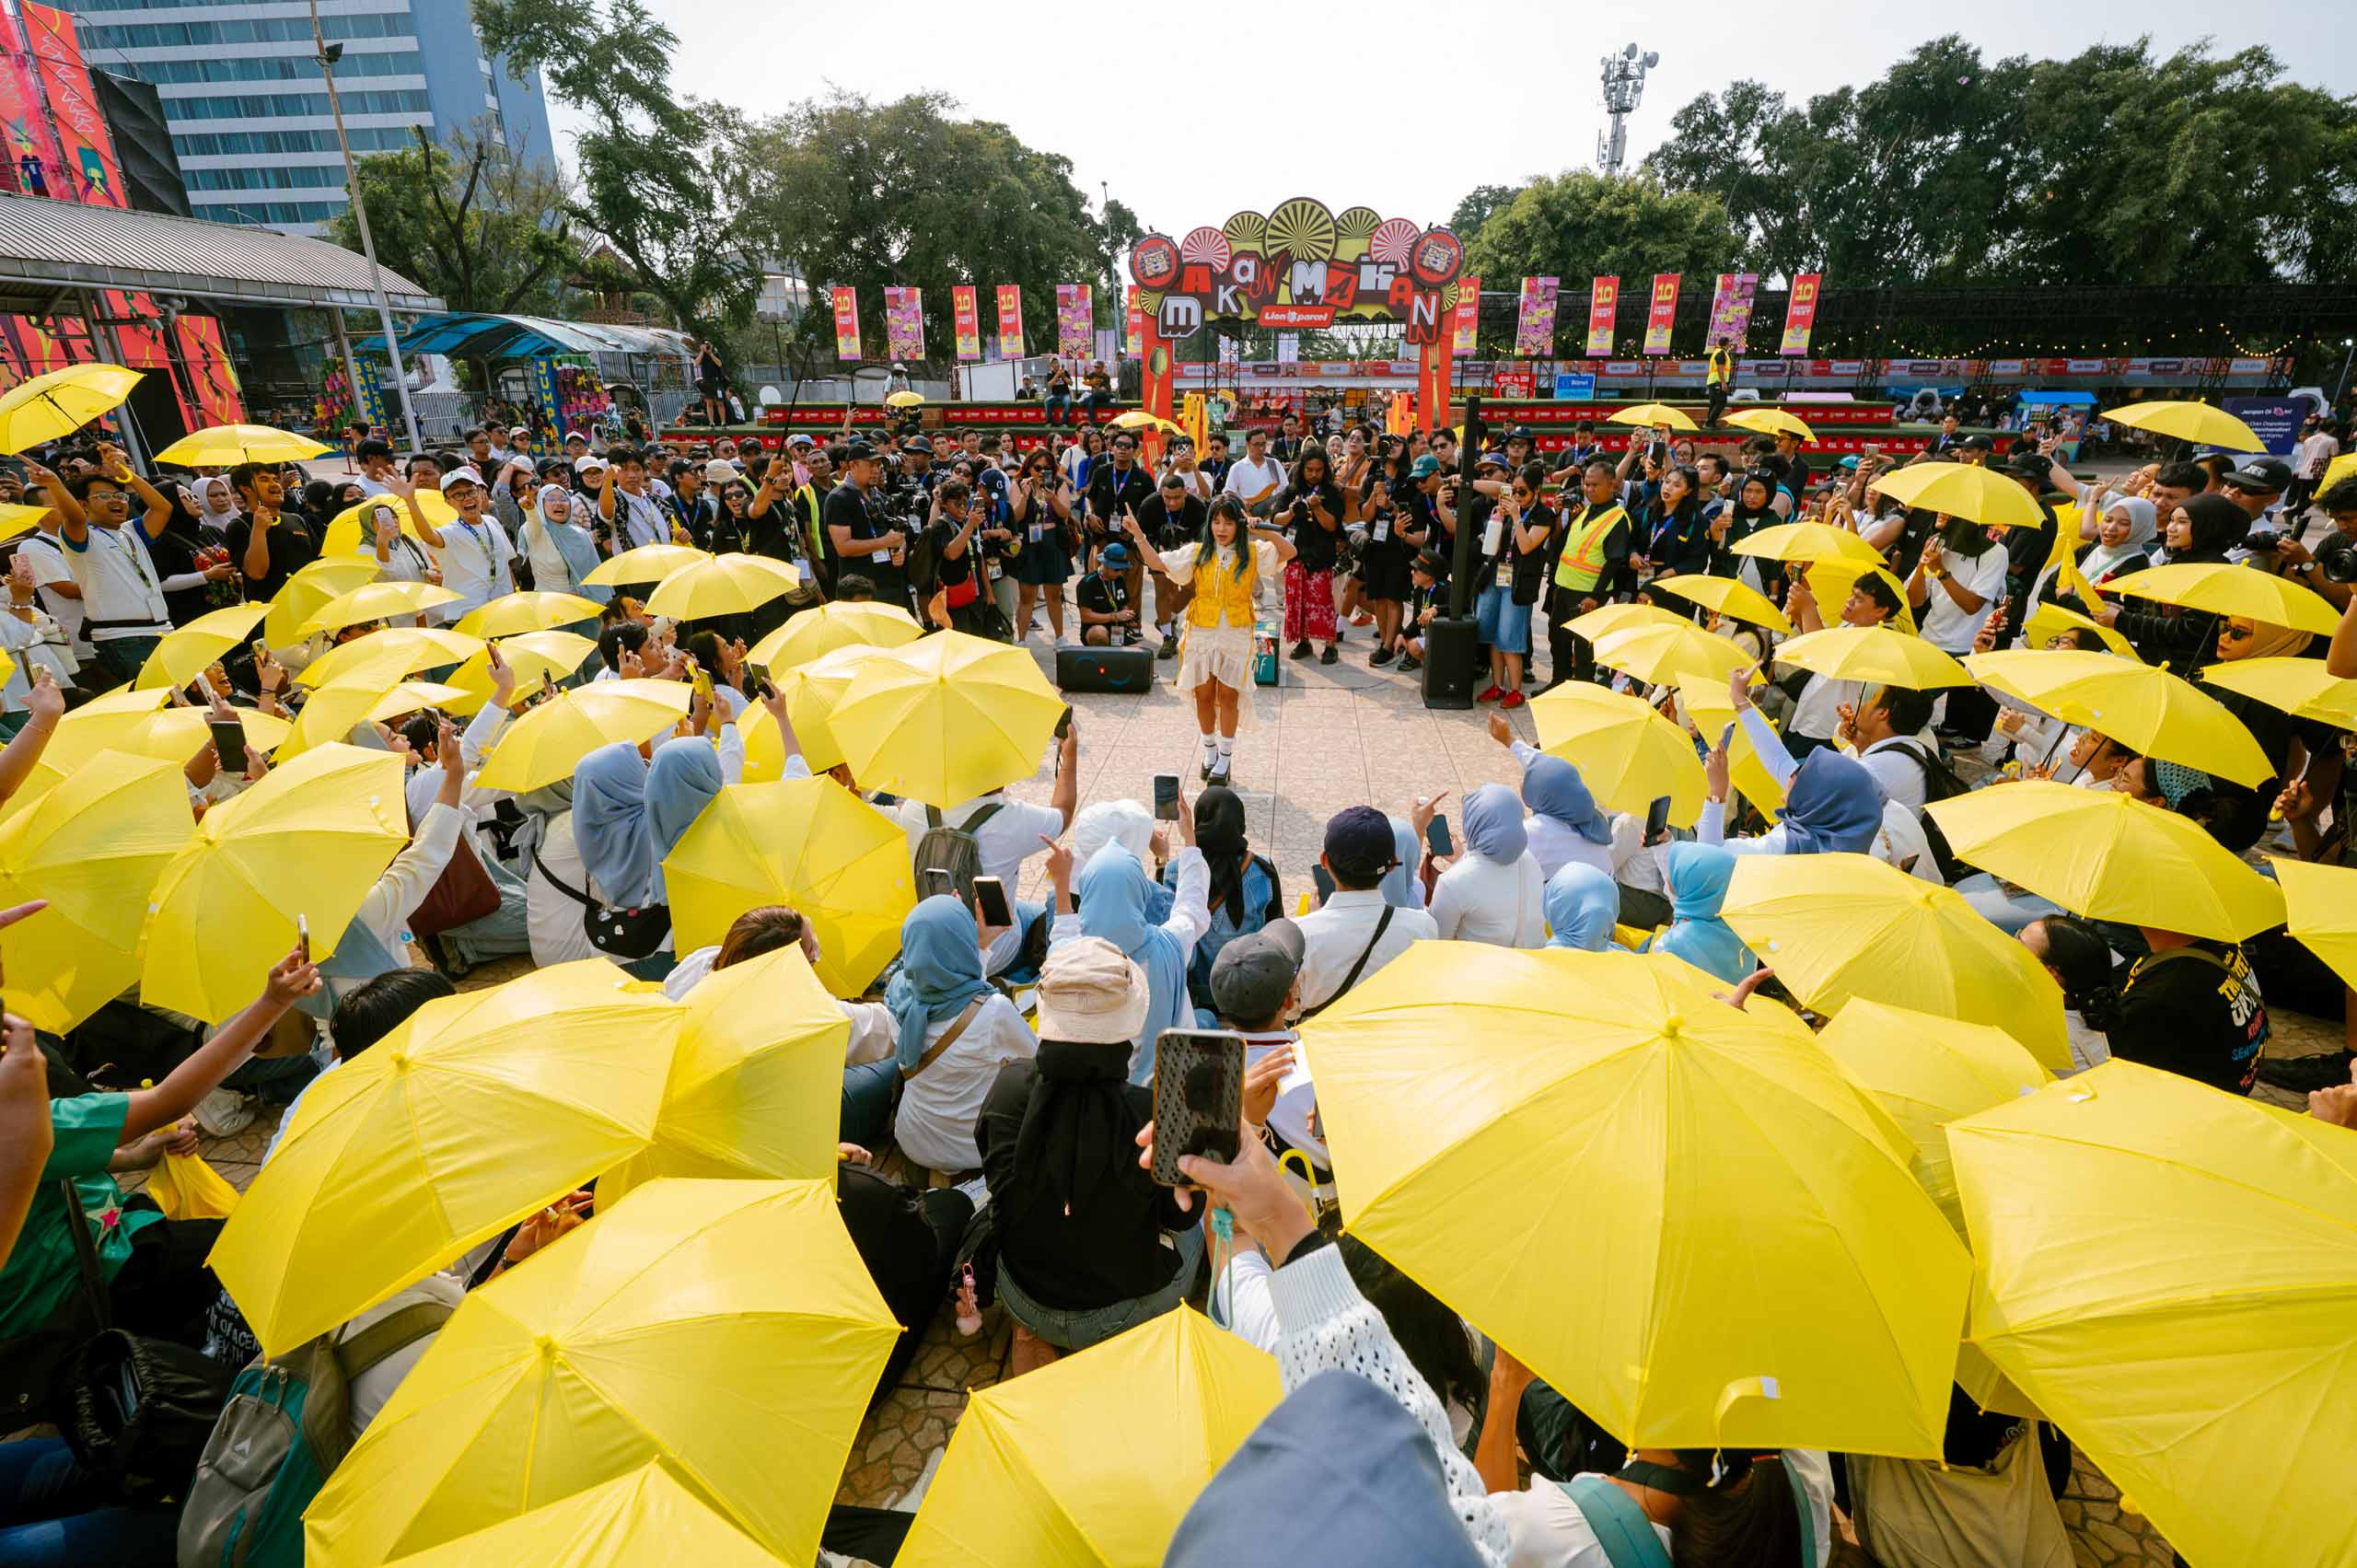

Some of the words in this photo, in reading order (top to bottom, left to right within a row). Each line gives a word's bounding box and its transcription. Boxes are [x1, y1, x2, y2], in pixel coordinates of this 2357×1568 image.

[1457, 285, 1475, 303] 10
[1596, 285, 1613, 304] 10
[1656, 283, 1675, 302] 10
[1794, 283, 1814, 302] 10
[836, 295, 851, 312] 10
[957, 294, 971, 311] 10
[1001, 294, 1015, 310] 10
[1265, 312, 1286, 320] Lion
[1296, 312, 1329, 322] parcel
